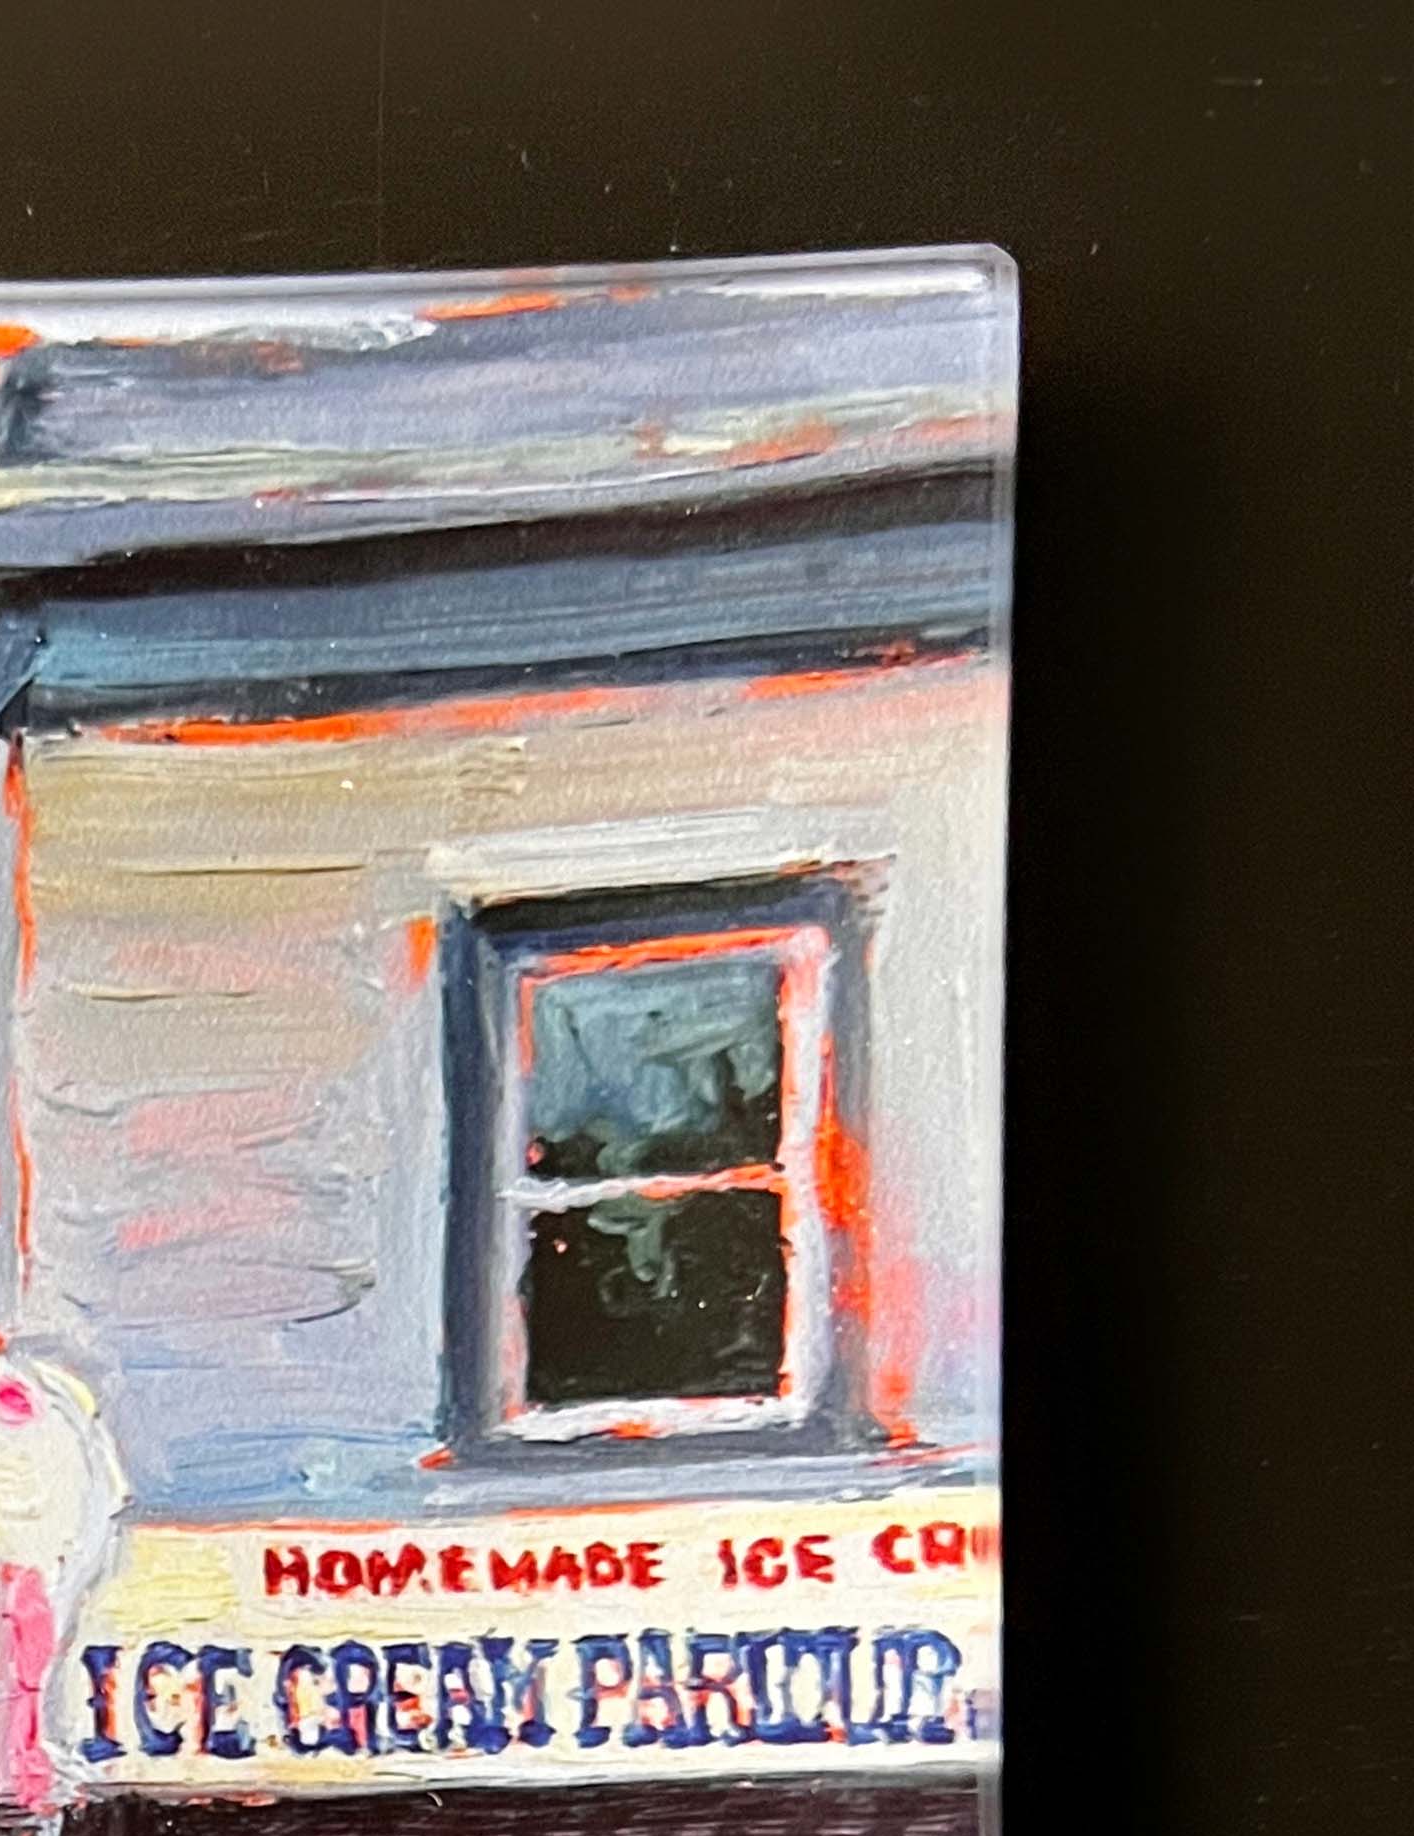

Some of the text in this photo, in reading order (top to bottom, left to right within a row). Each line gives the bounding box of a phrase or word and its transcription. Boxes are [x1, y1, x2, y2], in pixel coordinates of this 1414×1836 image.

[263, 1541, 668, 1597] HOMEMADE
[716, 1532, 836, 1590] ICE
[80, 1640, 256, 1763] ICE
[272, 1632, 561, 1756] CREAM
